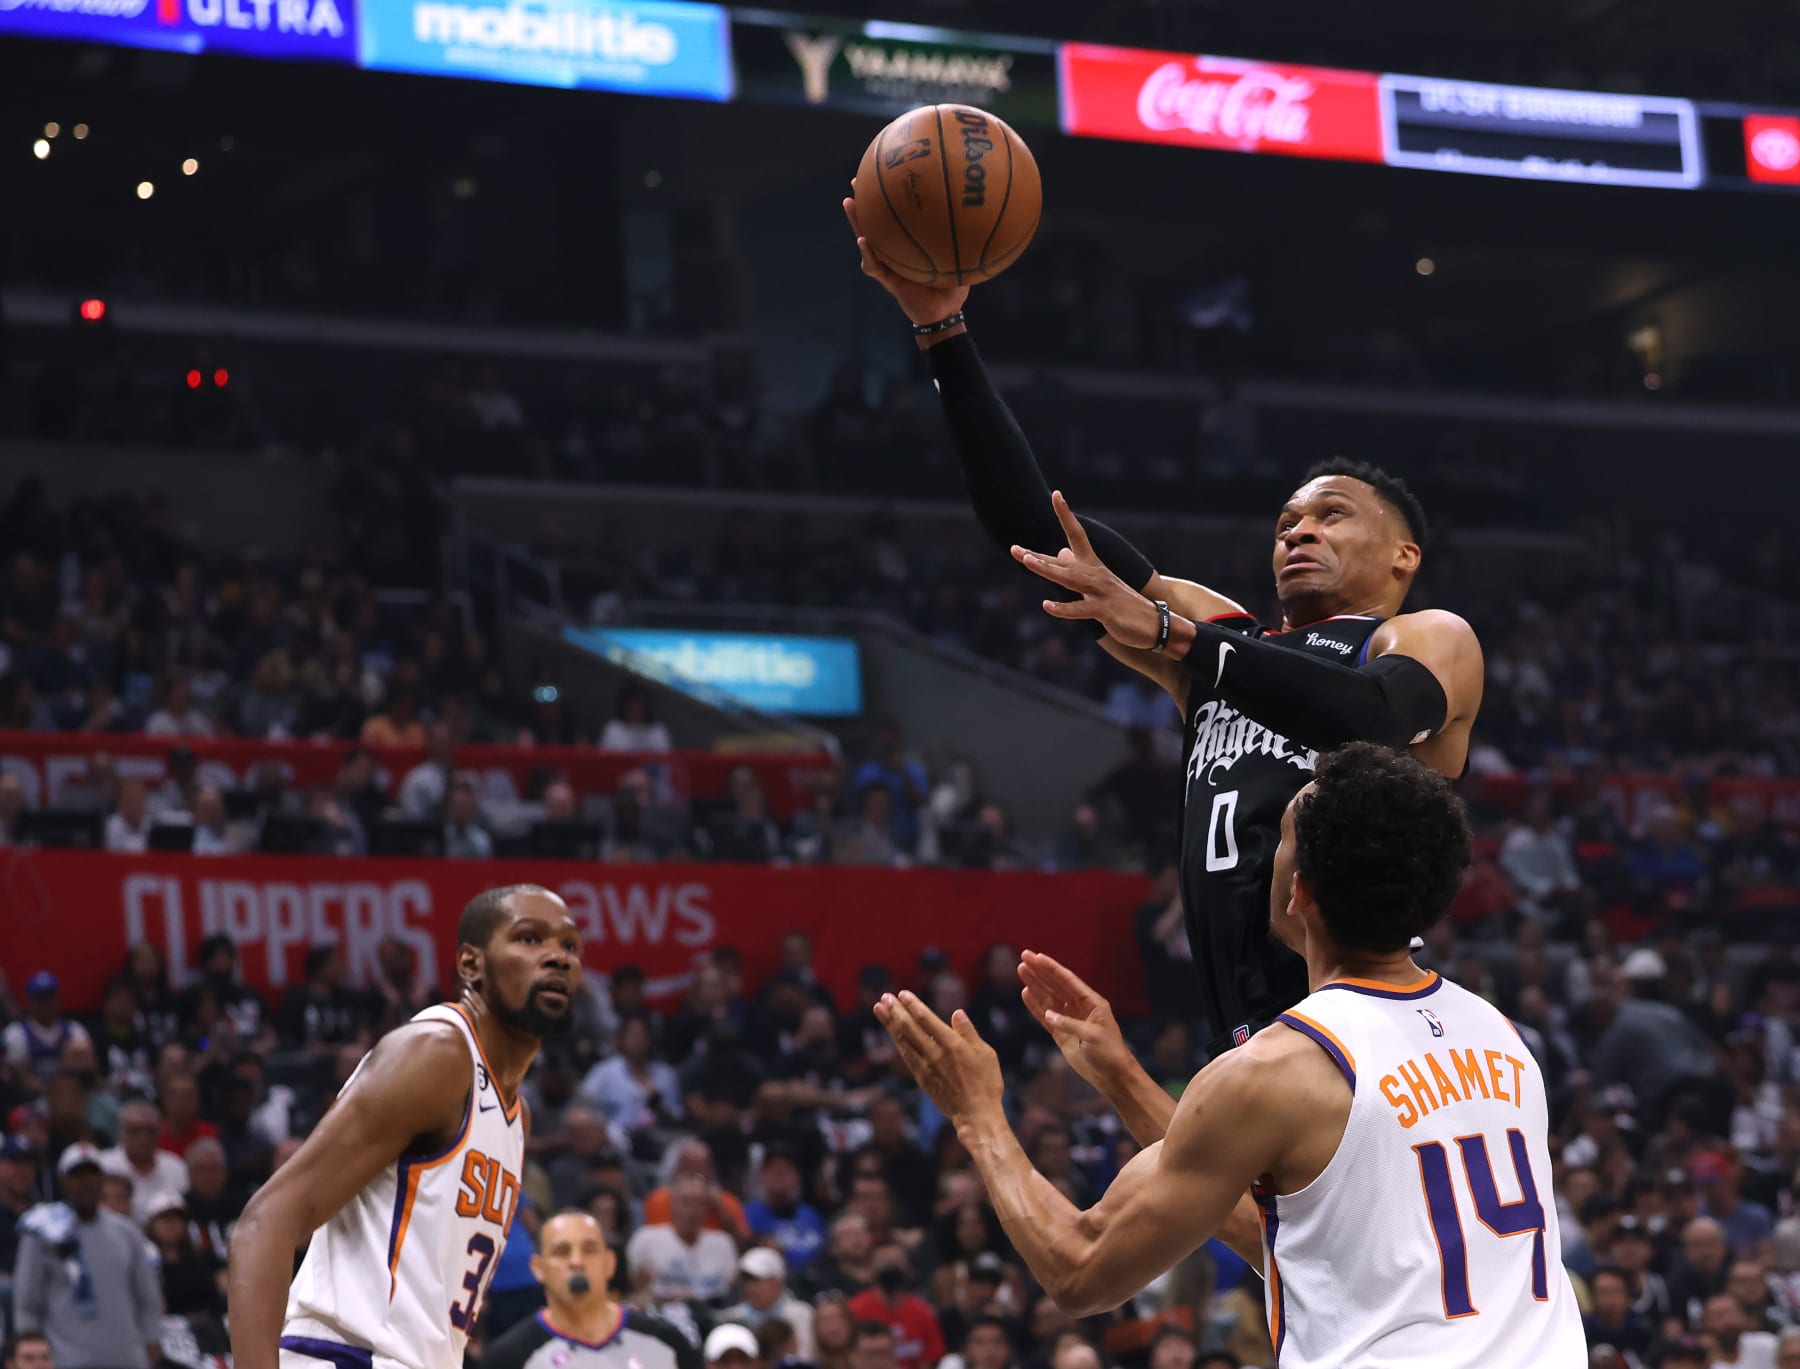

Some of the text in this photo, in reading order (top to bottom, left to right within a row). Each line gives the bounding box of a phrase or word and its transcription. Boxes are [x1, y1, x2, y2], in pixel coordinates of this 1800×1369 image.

[187, 0, 345, 38] ULTRA
[413, 3, 677, 66] mobilitie
[1305, 632, 1354, 655] honey
[1206, 790, 1239, 872] 0
[123, 874, 438, 990] CLIPPERS
[560, 880, 718, 947] aws
[1379, 1048, 1526, 1129] SHAMET
[1411, 1127, 1549, 1320] 14
[450, 1231, 501, 1337] 3
